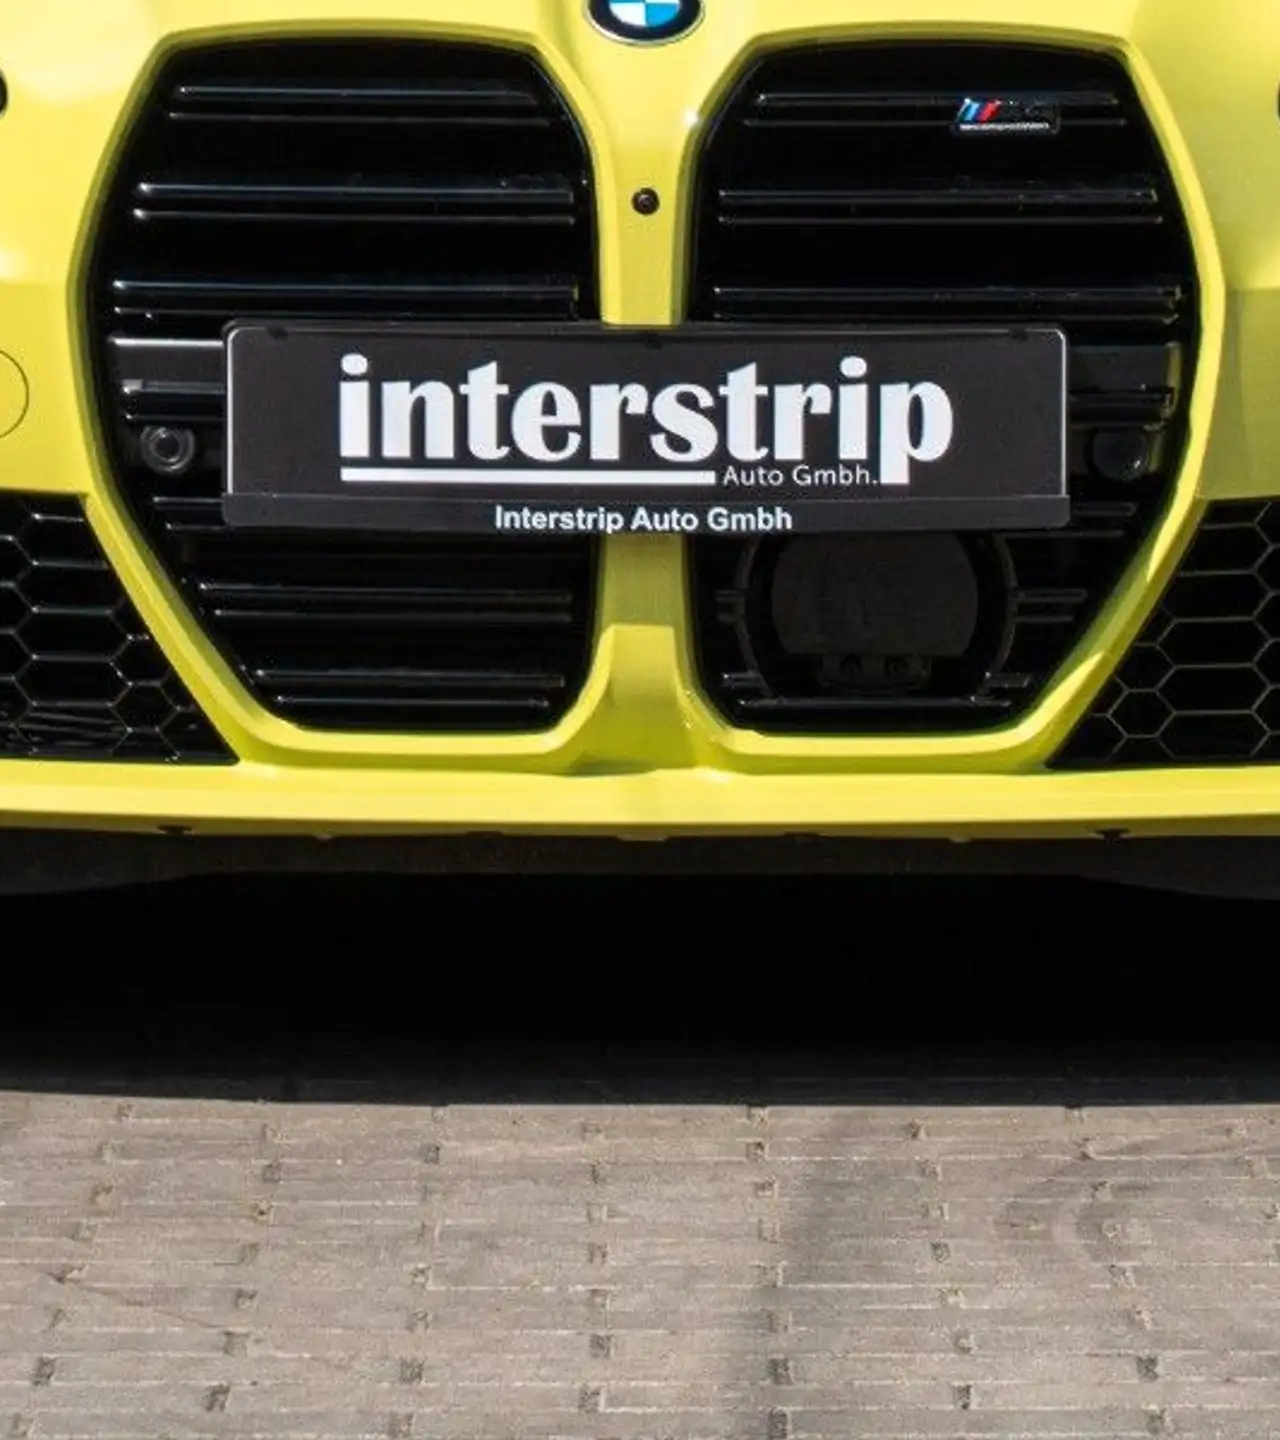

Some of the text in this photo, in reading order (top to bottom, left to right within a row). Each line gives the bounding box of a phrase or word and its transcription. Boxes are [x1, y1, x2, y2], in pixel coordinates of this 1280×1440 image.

[339, 353, 954, 486] interstrip
[723, 463, 879, 487] Auto Gmbh.
[494, 504, 794, 535] Interstrip Auto Gmbh
